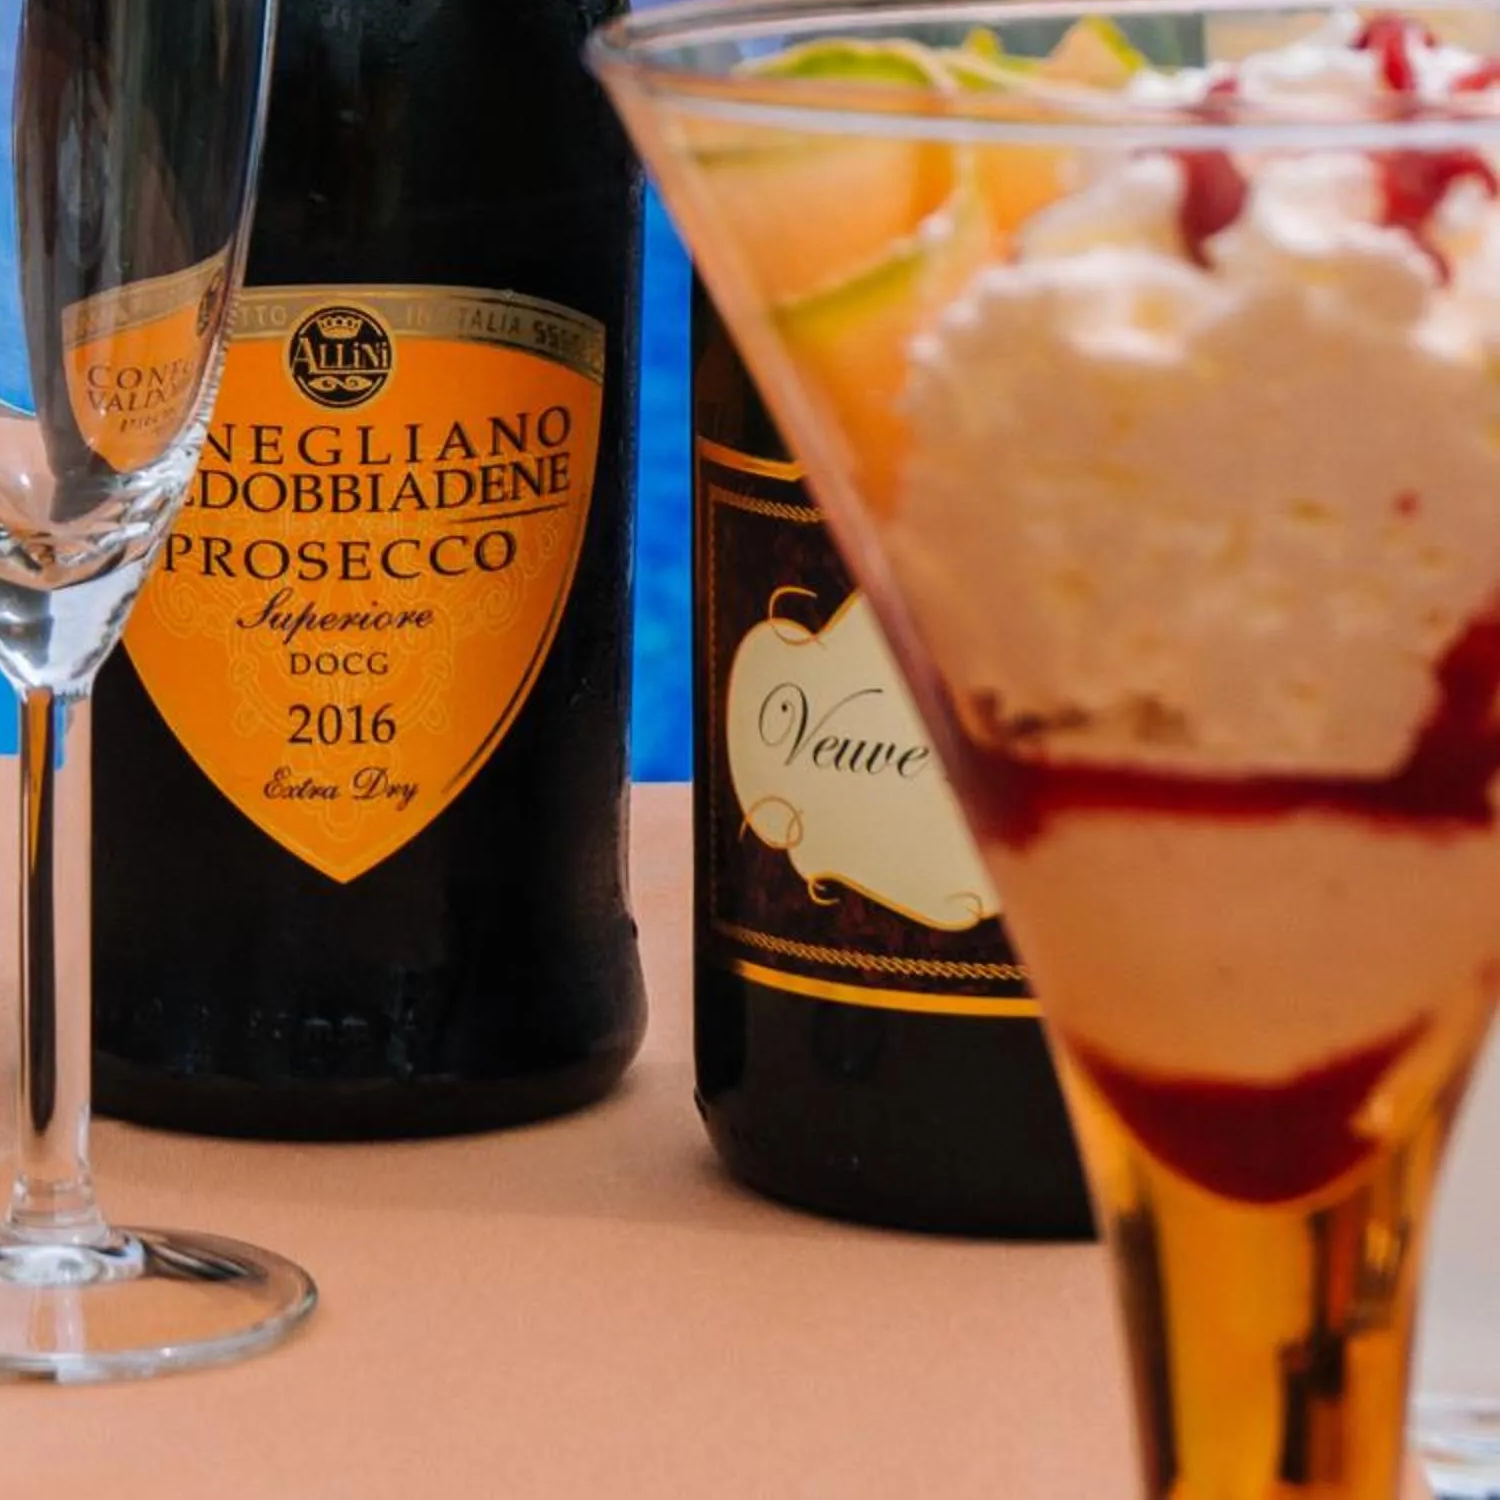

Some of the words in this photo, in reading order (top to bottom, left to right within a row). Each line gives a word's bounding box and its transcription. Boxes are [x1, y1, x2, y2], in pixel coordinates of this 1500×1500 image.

[164, 530, 518, 582] PROSECCO
[236, 587, 435, 646] Superiore
[289, 652, 389, 676] DOCG
[287, 704, 397, 746] 2016
[758, 682, 931, 779] Veuve
[263, 766, 340, 802] Extra
[352, 766, 419, 811] Dry
